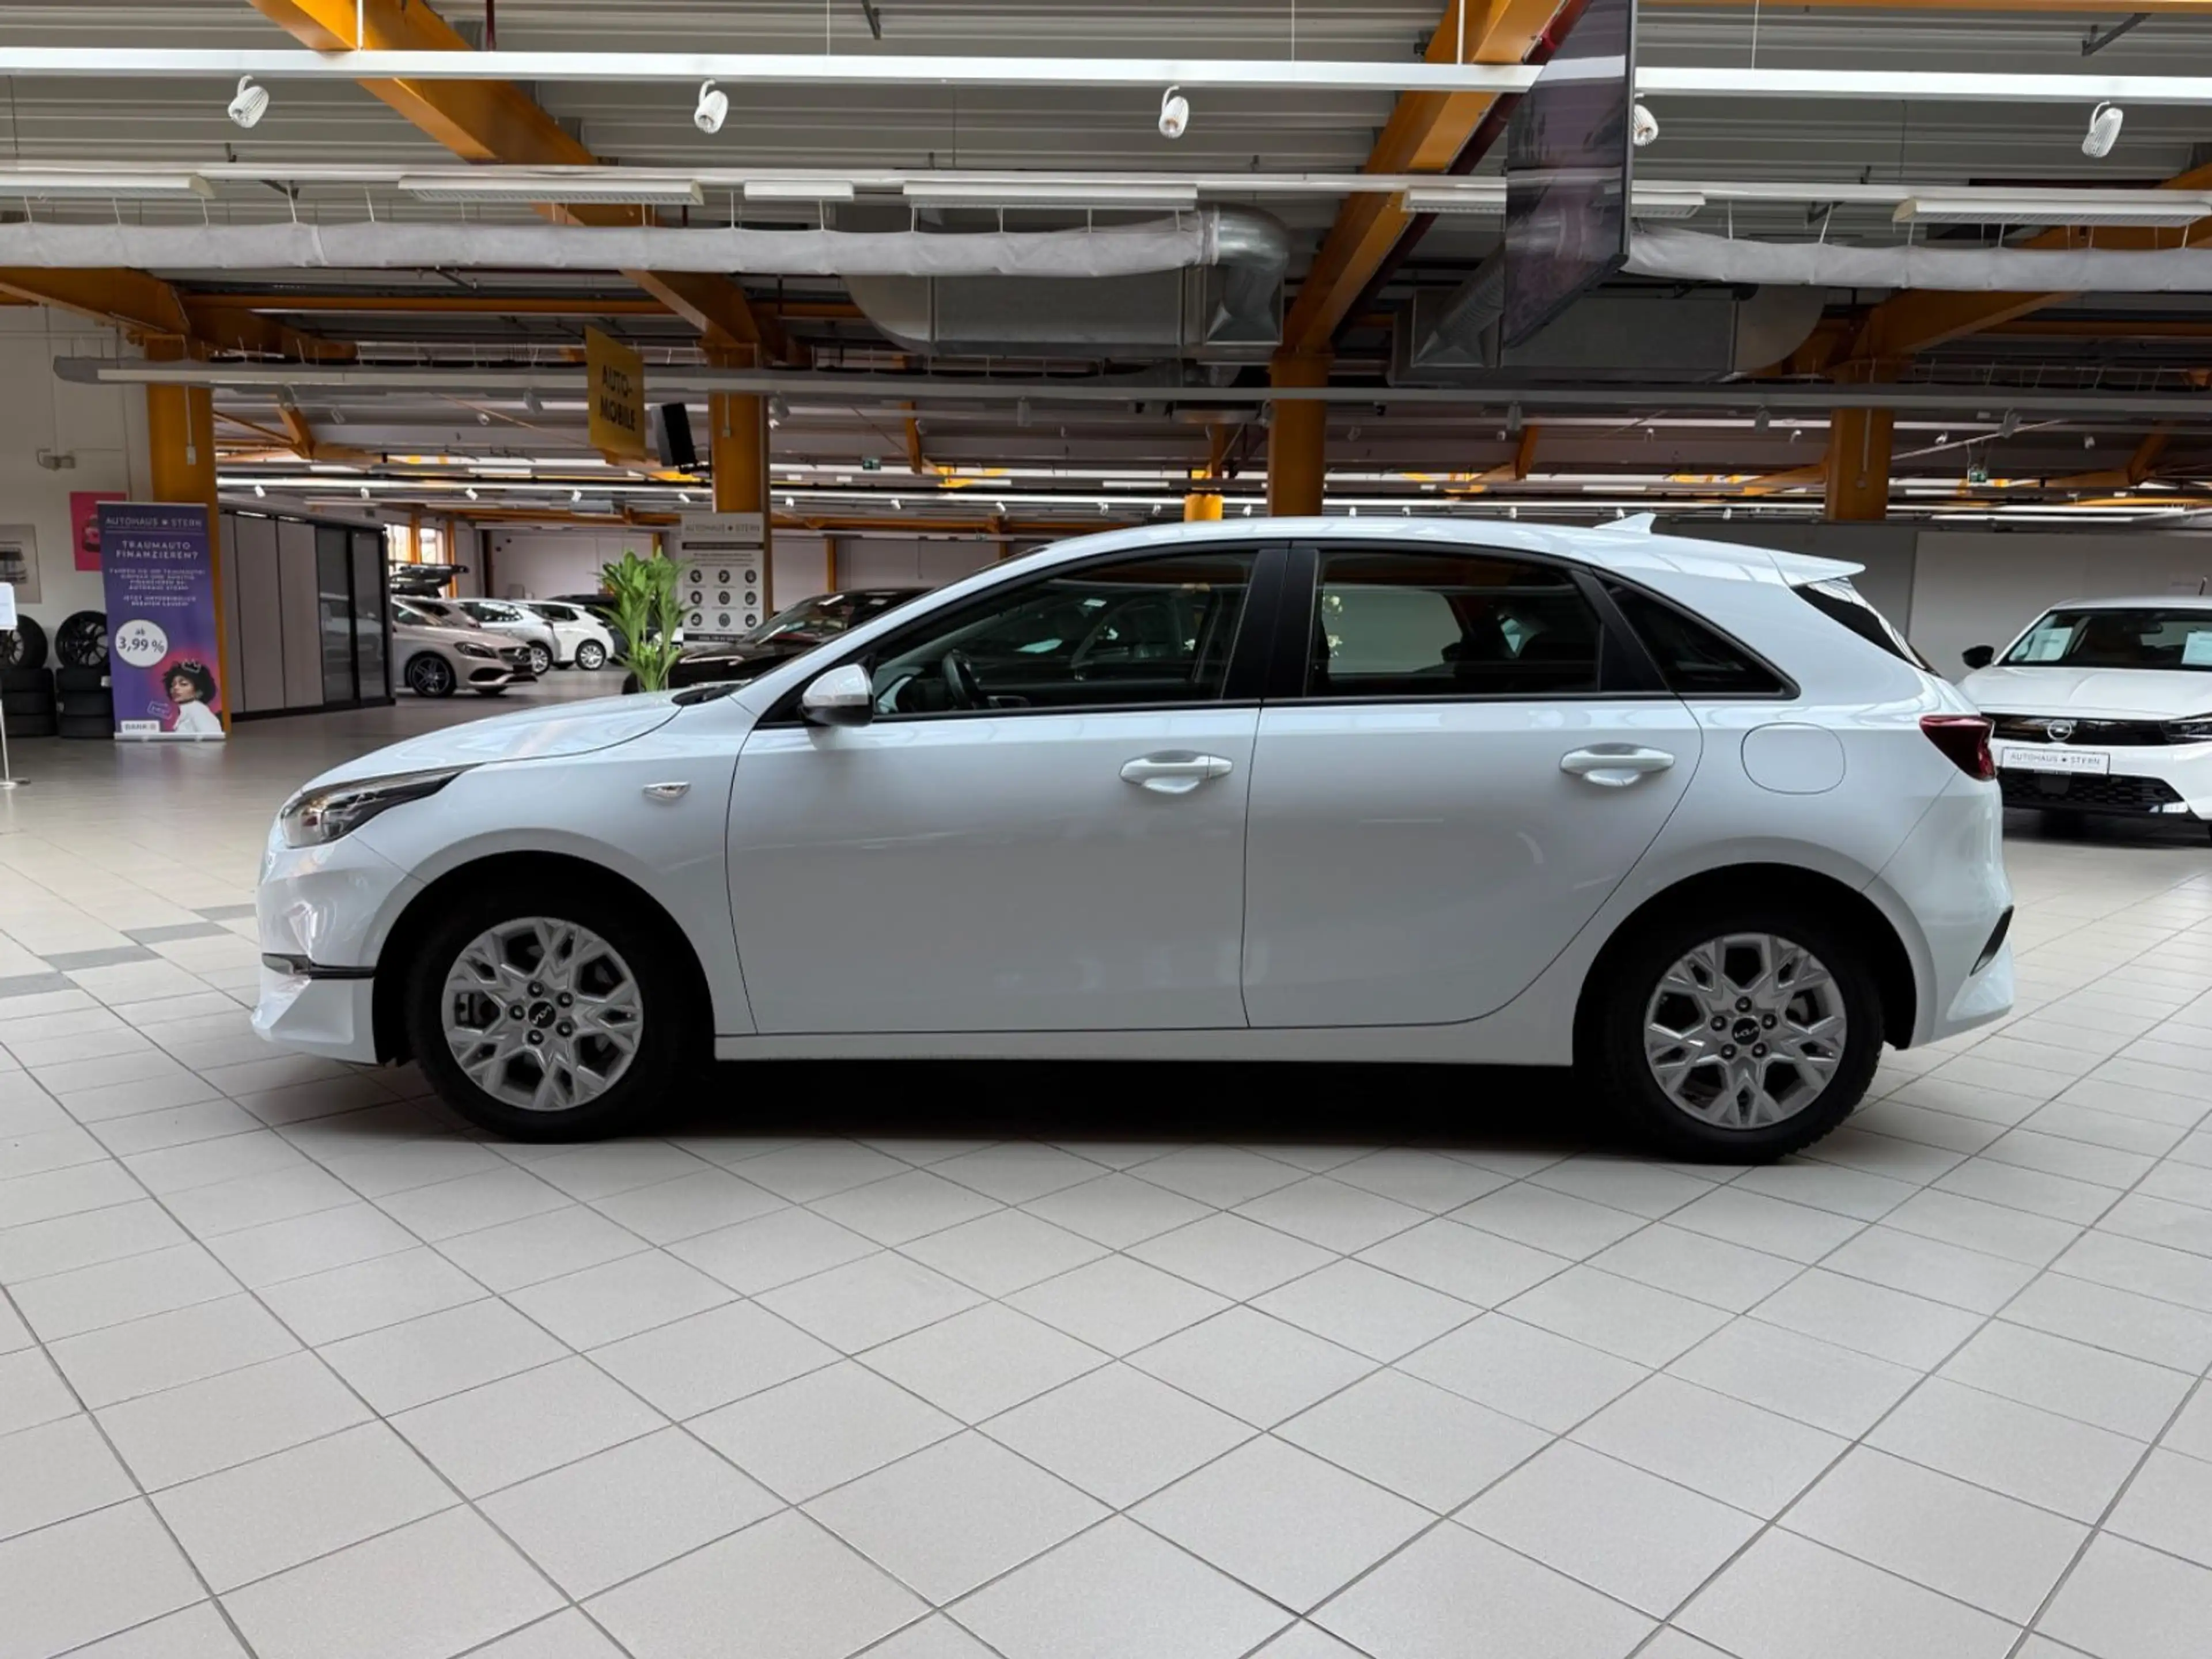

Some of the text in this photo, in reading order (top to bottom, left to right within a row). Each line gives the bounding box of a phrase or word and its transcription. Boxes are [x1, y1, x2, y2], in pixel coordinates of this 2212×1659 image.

[602, 365, 632, 397] AUTO-
[600, 394, 635, 432] MOBILE
[105, 517, 158, 527] AUTOHAUS
[122, 540, 191, 550] TRAUMAUTO
[116, 549, 199, 560] FINANZIEREN?
[135, 627, 145, 636] ab
[118, 636, 165, 654] 3,99 %
[2070, 756, 2100, 764] STERN
